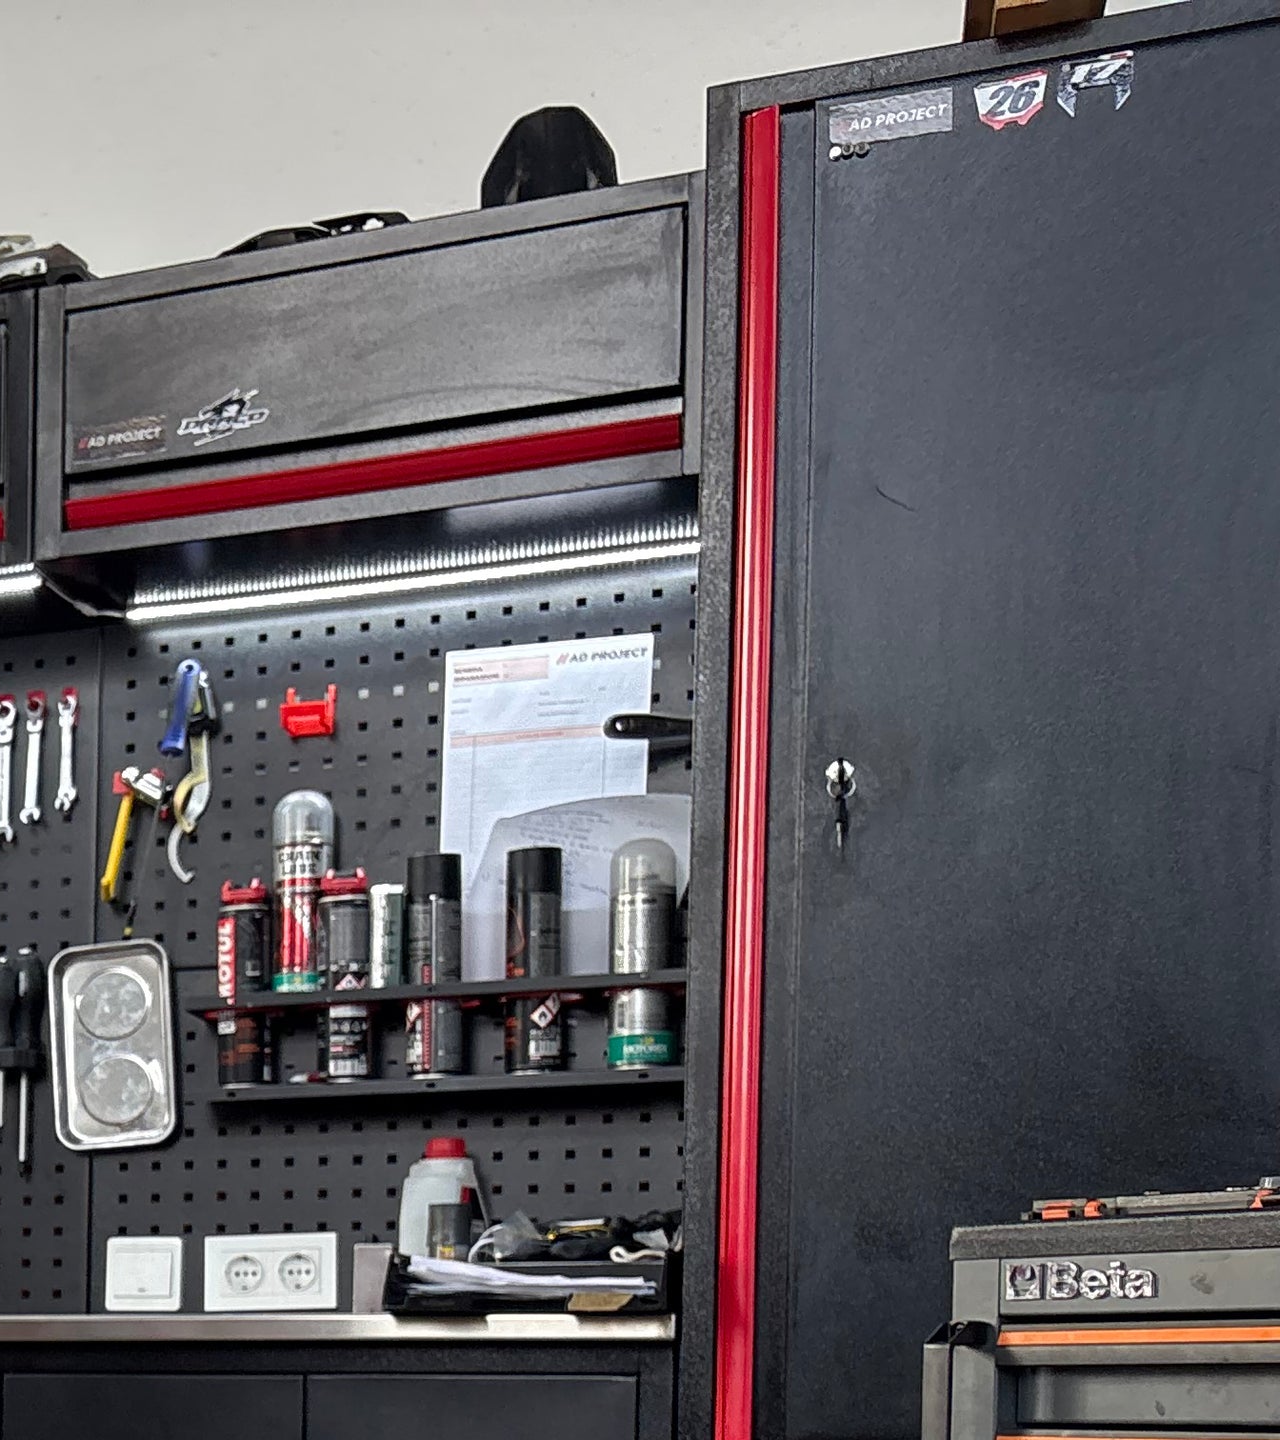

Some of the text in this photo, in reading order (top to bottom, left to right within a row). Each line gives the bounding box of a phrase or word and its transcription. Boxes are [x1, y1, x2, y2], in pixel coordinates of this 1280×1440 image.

[988, 80, 1038, 118] 26
[875, 103, 949, 127] PROJECT
[107, 426, 162, 447] PROJECT
[1045, 1261, 1158, 1300] Beta
